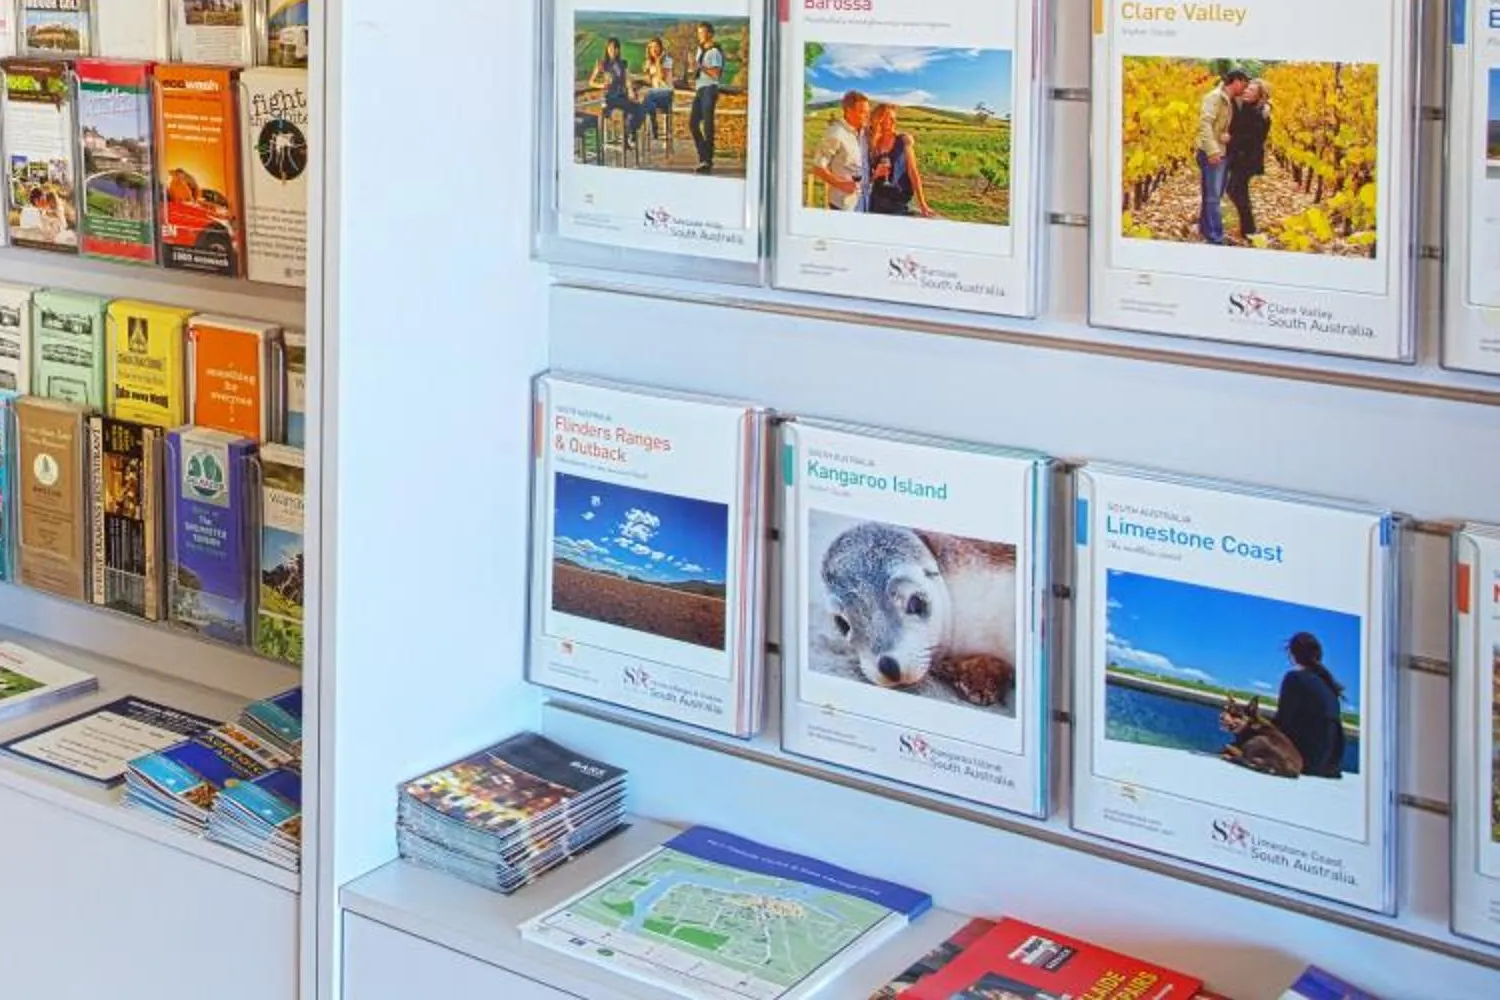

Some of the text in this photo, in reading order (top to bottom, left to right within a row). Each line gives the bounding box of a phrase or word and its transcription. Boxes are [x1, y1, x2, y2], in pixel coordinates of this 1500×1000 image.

[1121, 1, 1248, 27] Clare Valley
[253, 88, 307, 117] fight
[920, 277, 1007, 299] South Australia
[1267, 314, 1375, 340] South Australia
[555, 415, 672, 454] Flinders Ranges
[555, 435, 627, 464] & Outback
[807, 459, 948, 501] Kangaroo Island
[1106, 514, 1215, 551] Limestone
[1221, 533, 1284, 564] Coast
[930, 757, 1016, 788] South Australia
[1250, 844, 1359, 888] South Australia
